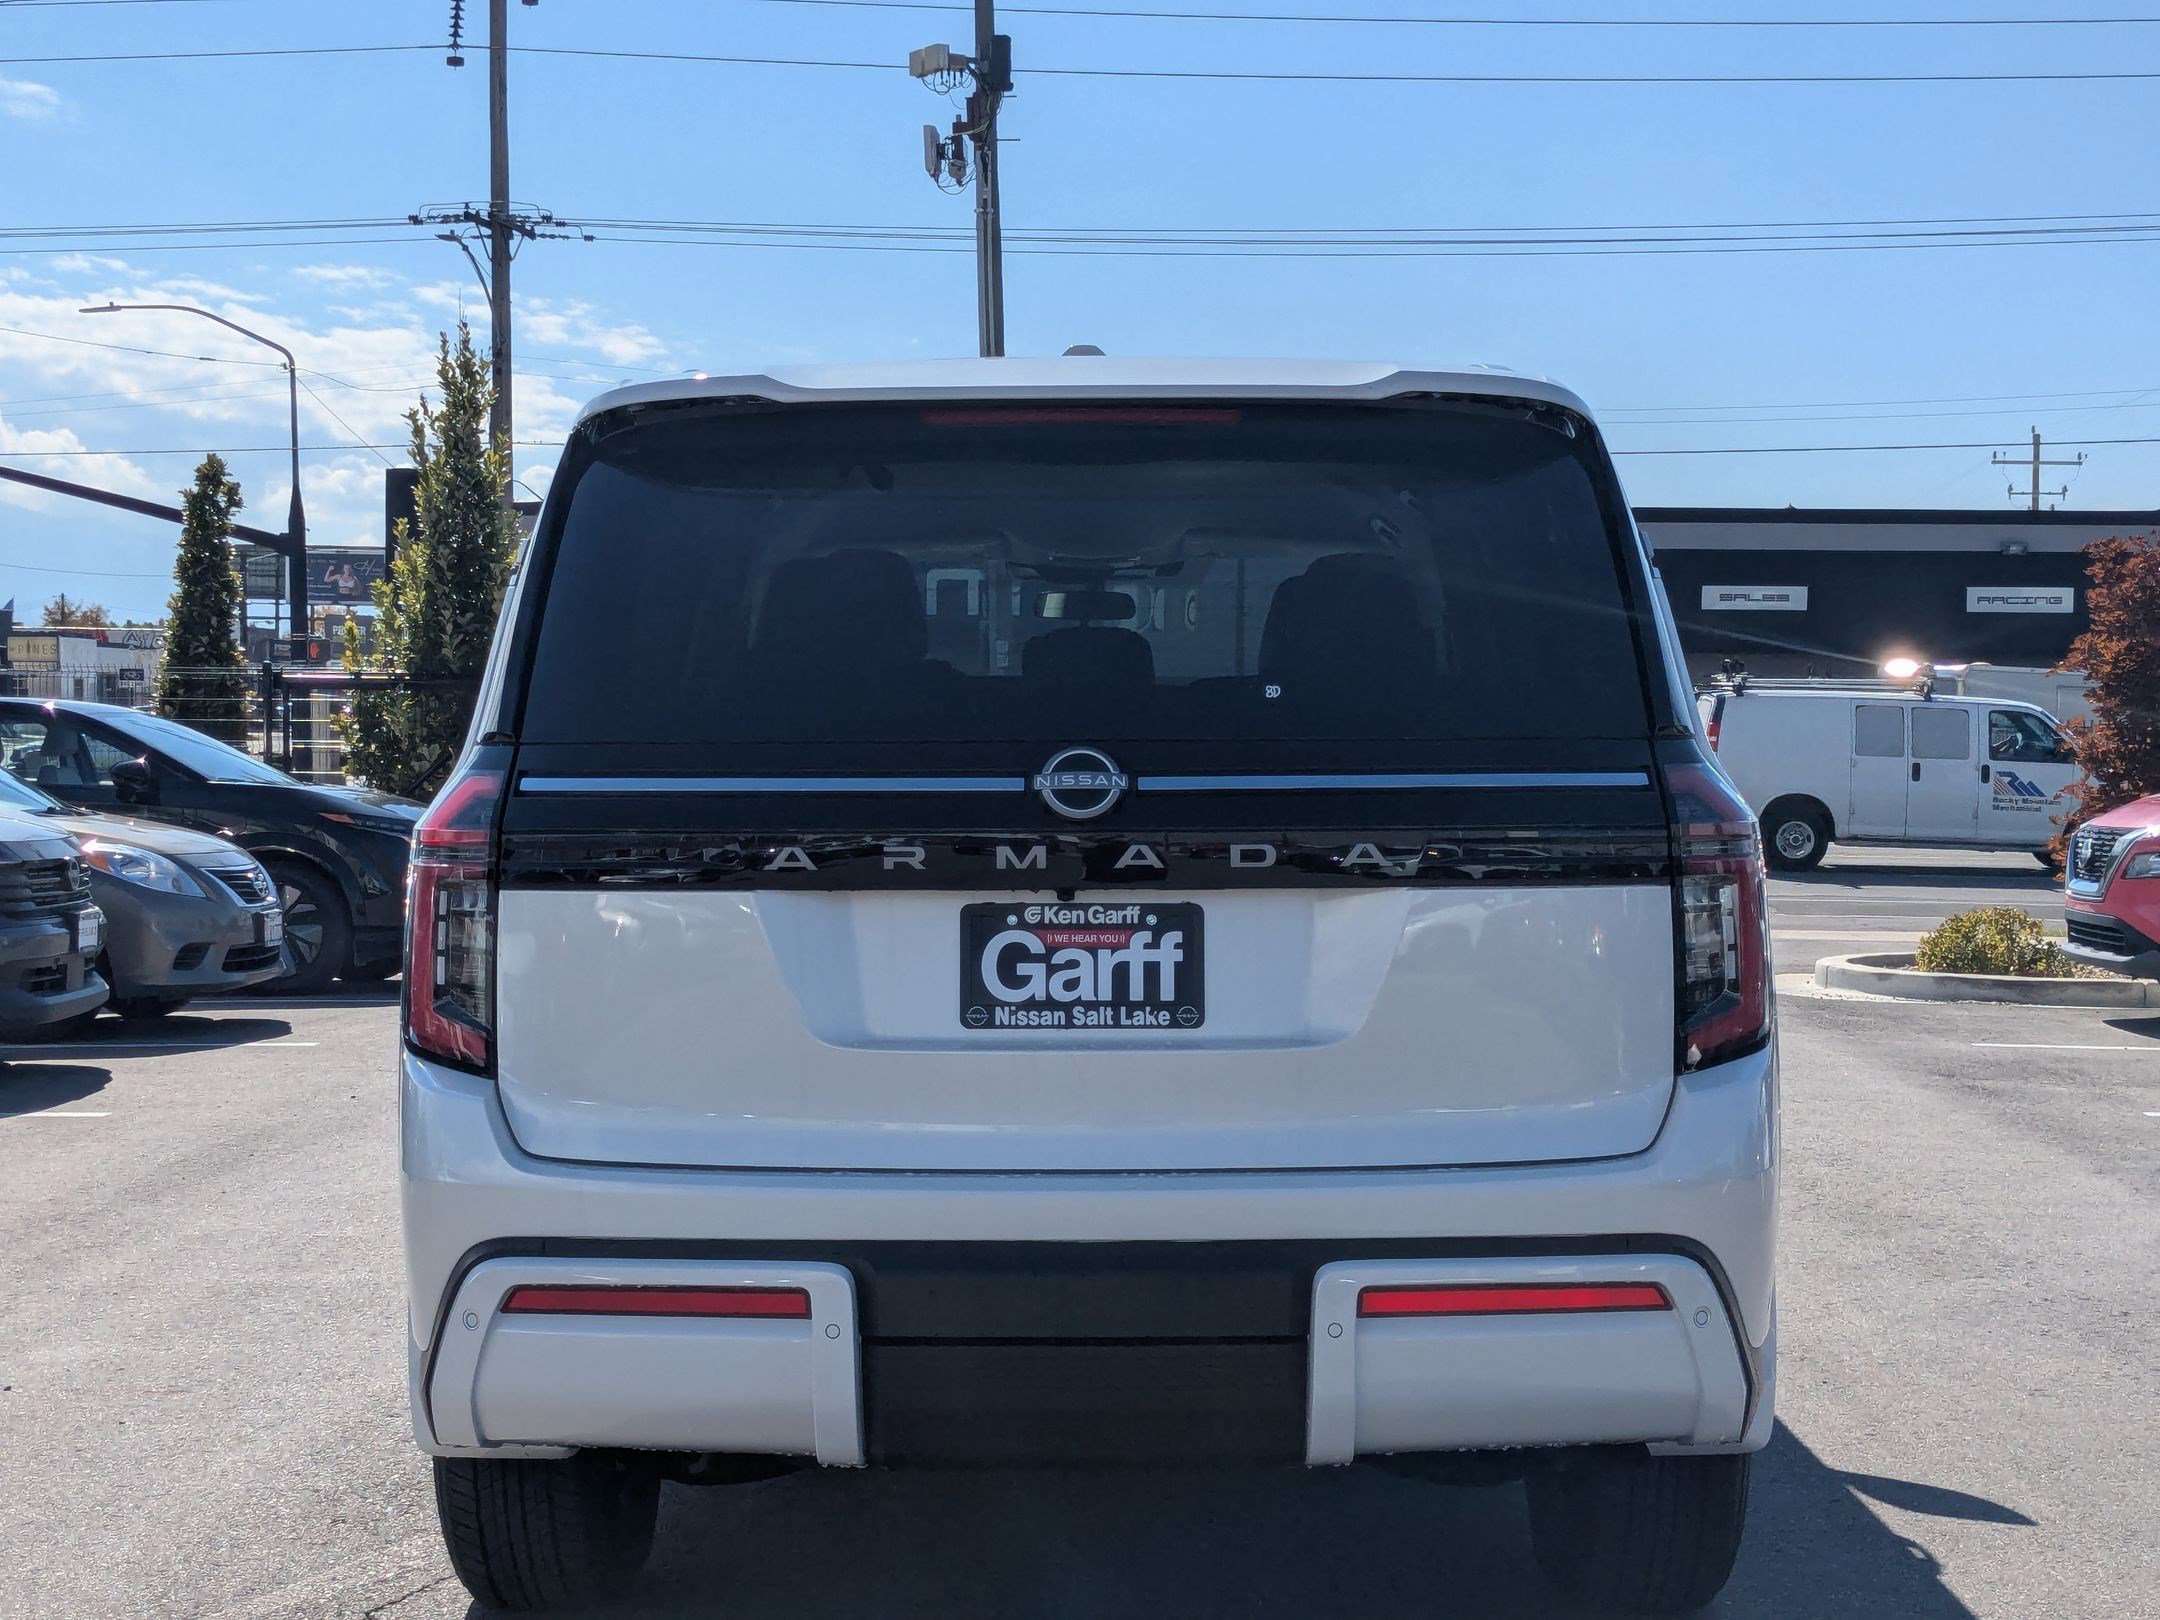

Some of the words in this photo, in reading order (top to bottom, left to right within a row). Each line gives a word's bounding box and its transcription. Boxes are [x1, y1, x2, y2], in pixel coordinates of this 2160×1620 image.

[1976, 595, 2064, 605] RACING
[1036, 774, 1126, 787] NISSAN
[763, 843, 1394, 870] ARMADA
[1044, 906, 1085, 924] Ken
[1087, 905, 1140, 924] Garff
[1054, 934, 1069, 943] WE
[1071, 934, 1098, 943] HEAR
[1099, 934, 1119, 943] YOU
[981, 930, 1183, 1002] Garff
[995, 1006, 1065, 1026] Nissan
[1072, 1006, 1113, 1026] Salt
[1120, 1006, 1171, 1026] Lake
